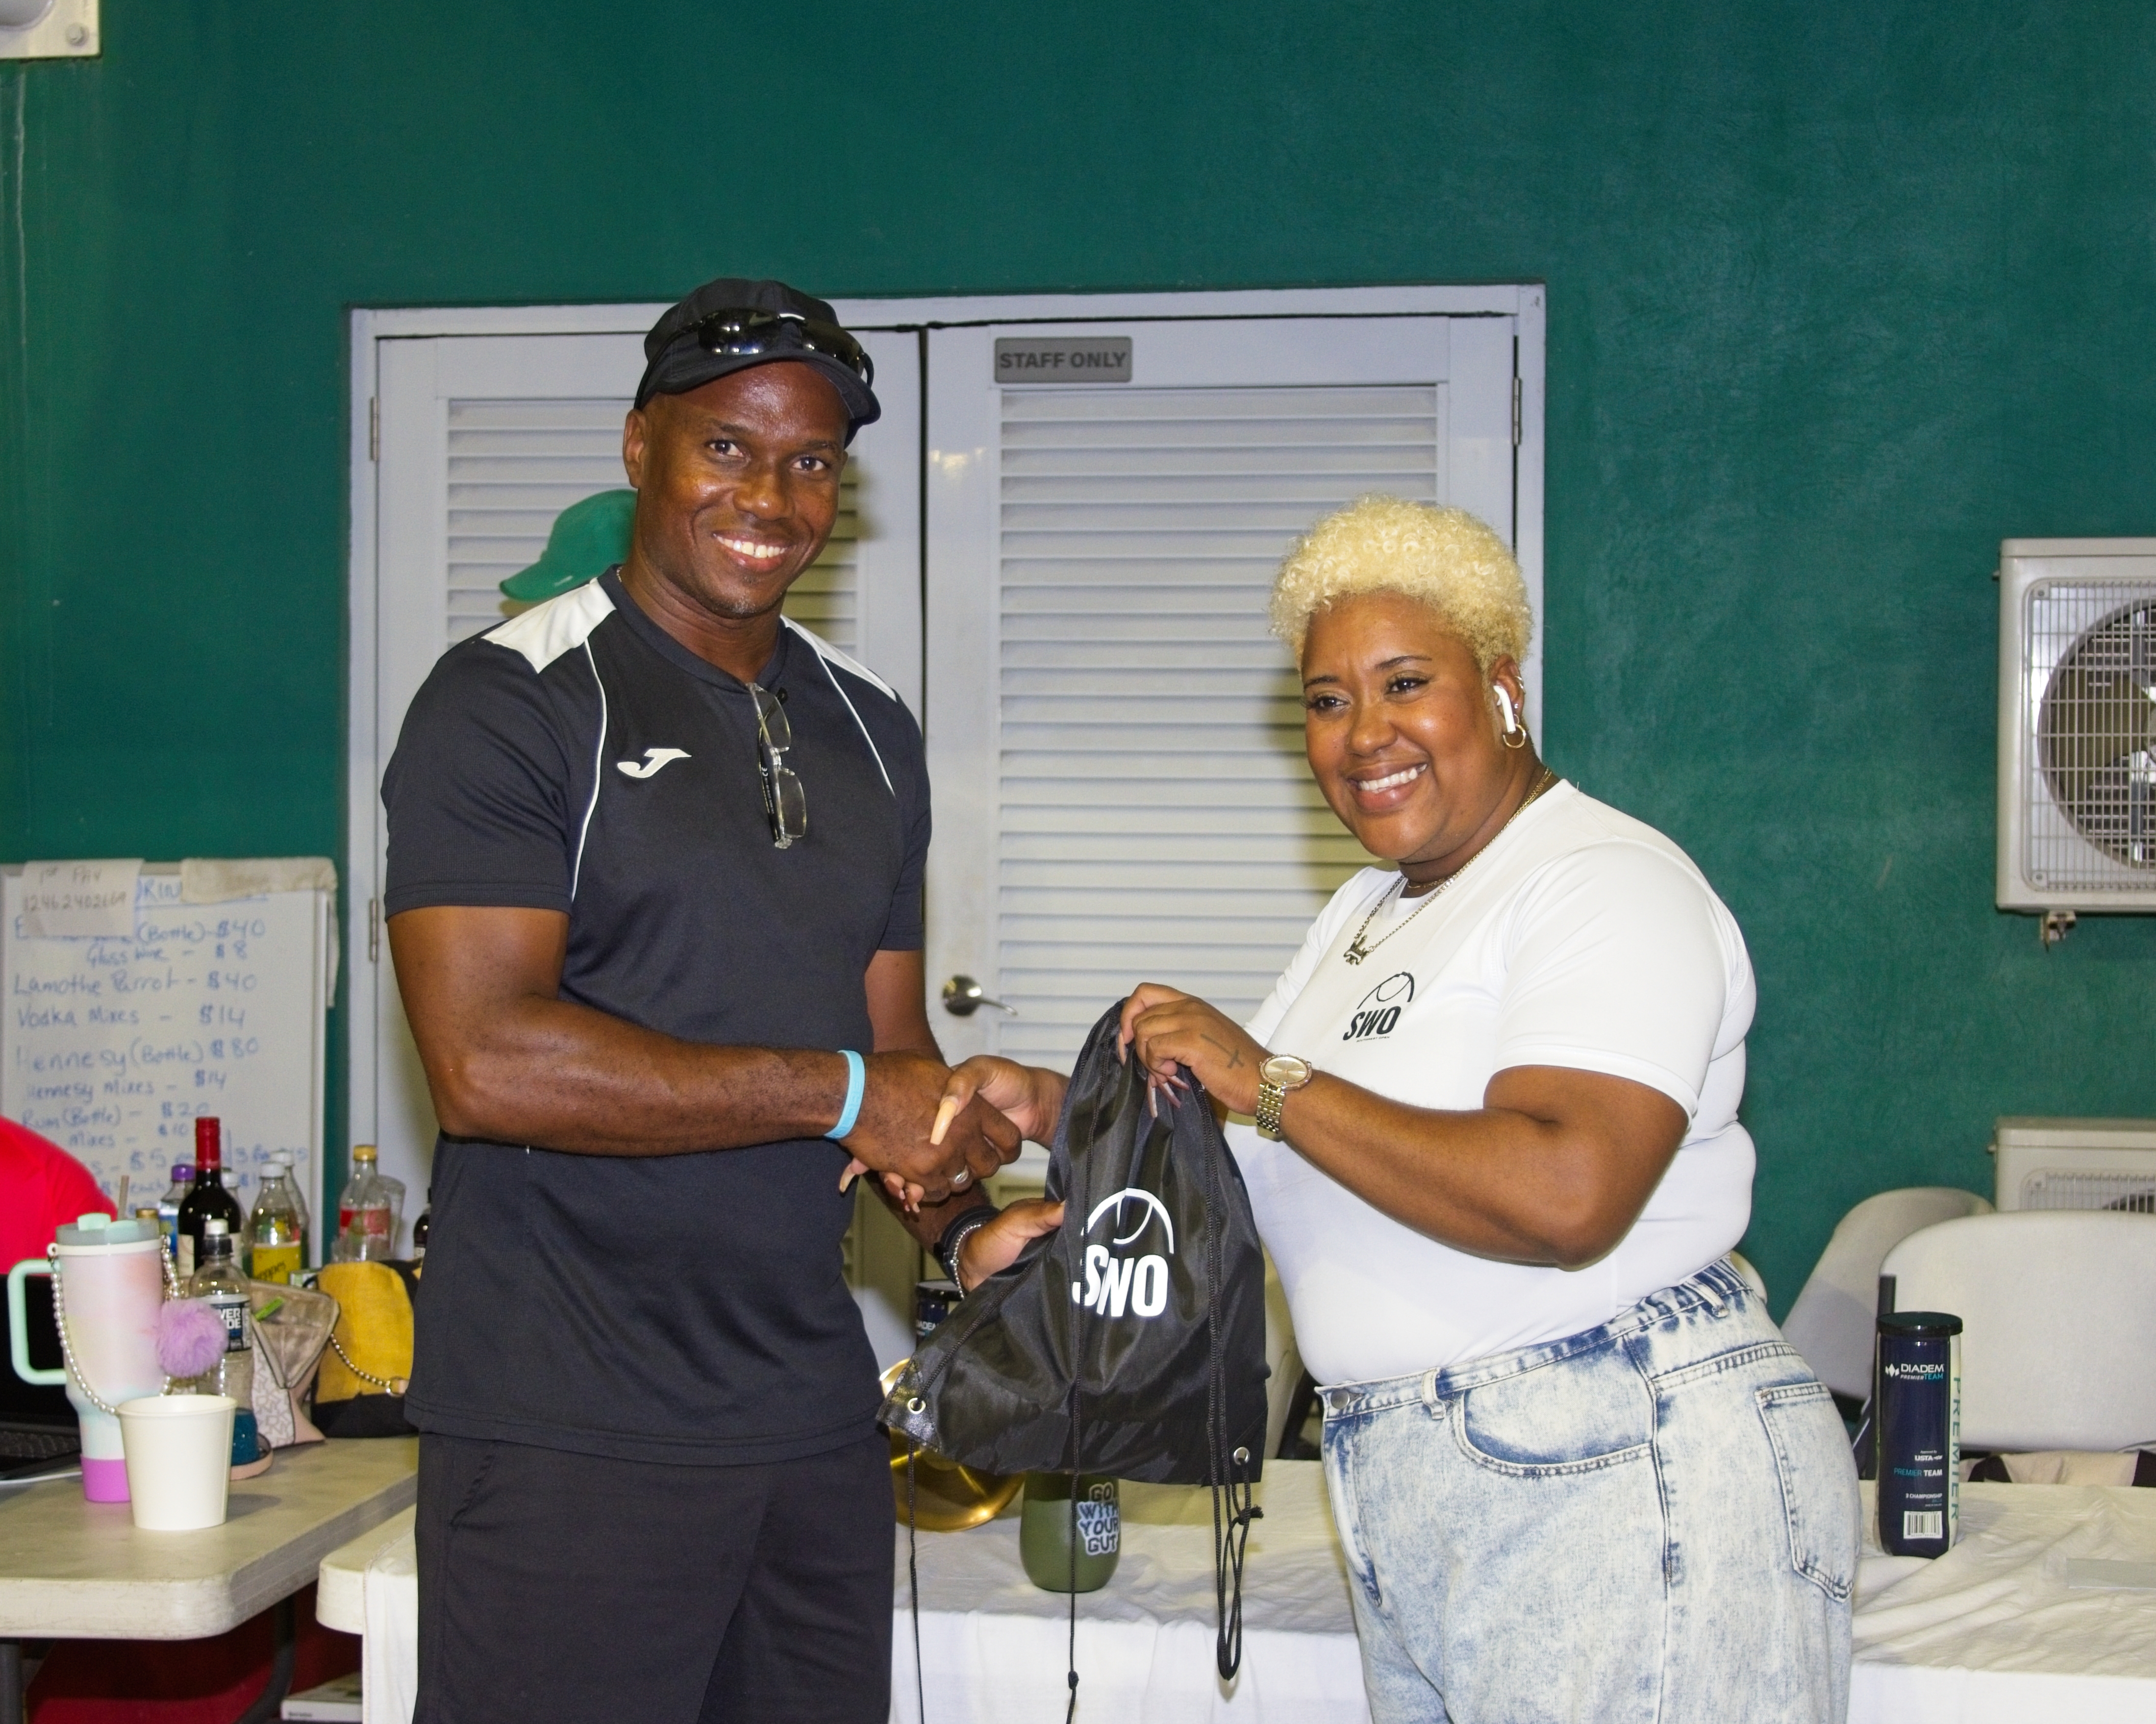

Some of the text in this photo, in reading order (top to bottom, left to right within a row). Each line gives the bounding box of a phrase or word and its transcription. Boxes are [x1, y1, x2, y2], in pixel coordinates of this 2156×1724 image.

[1000, 352, 1126, 368] STAFF ONLY
[18, 1004, 76, 1028] Vodka
[1343, 1006, 1401, 1040] SWO
[1901, 1363, 1944, 1373] DIADEM
[1894, 1468, 1922, 1476] PREMIER
[1092, 1486, 1112, 1501] GO
[1079, 1518, 1119, 1536] YOUR
[1088, 1534, 1117, 1553] GUT
